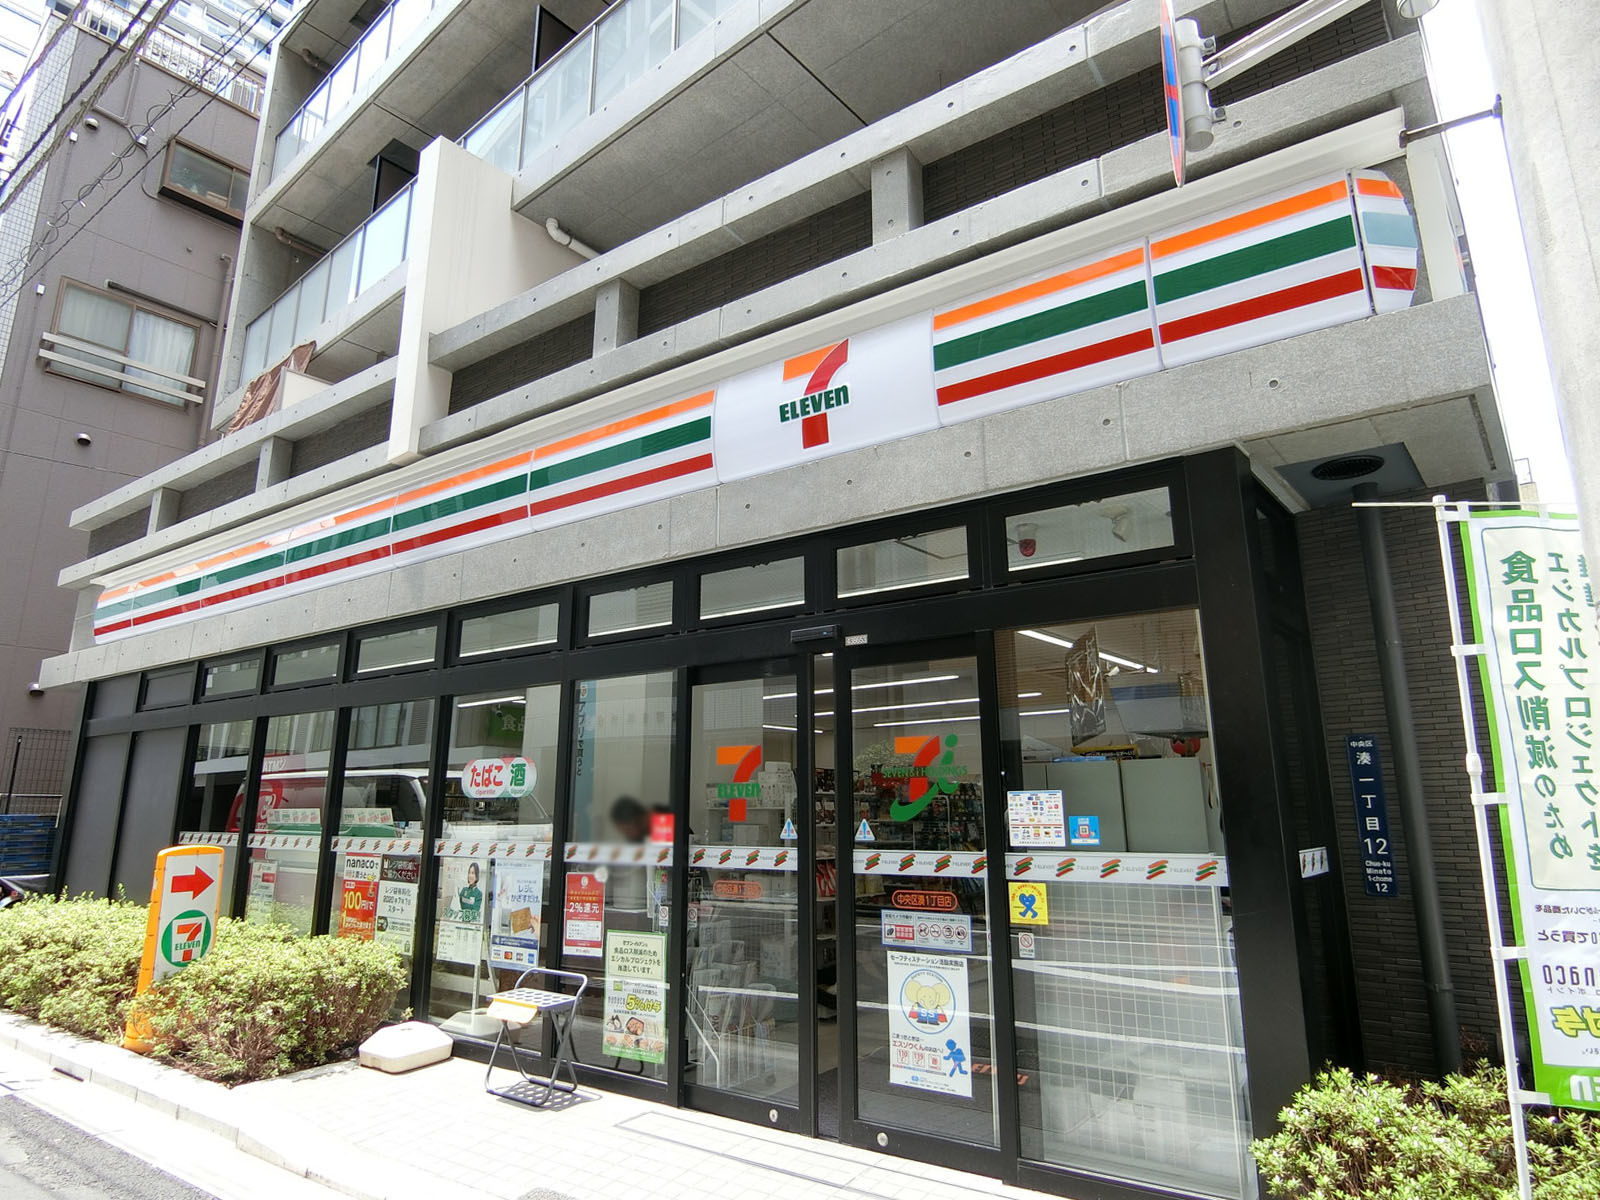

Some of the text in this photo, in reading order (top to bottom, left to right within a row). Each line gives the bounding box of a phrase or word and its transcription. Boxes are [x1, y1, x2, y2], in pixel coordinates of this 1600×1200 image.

[470, 763, 526, 788] たばこ 酒
[1356, 752, 1379, 831] 湊一丁目
[1364, 838, 1388, 854] 12
[1366, 867, 1392, 875] Minato
[1375, 883, 1389, 892] 12
